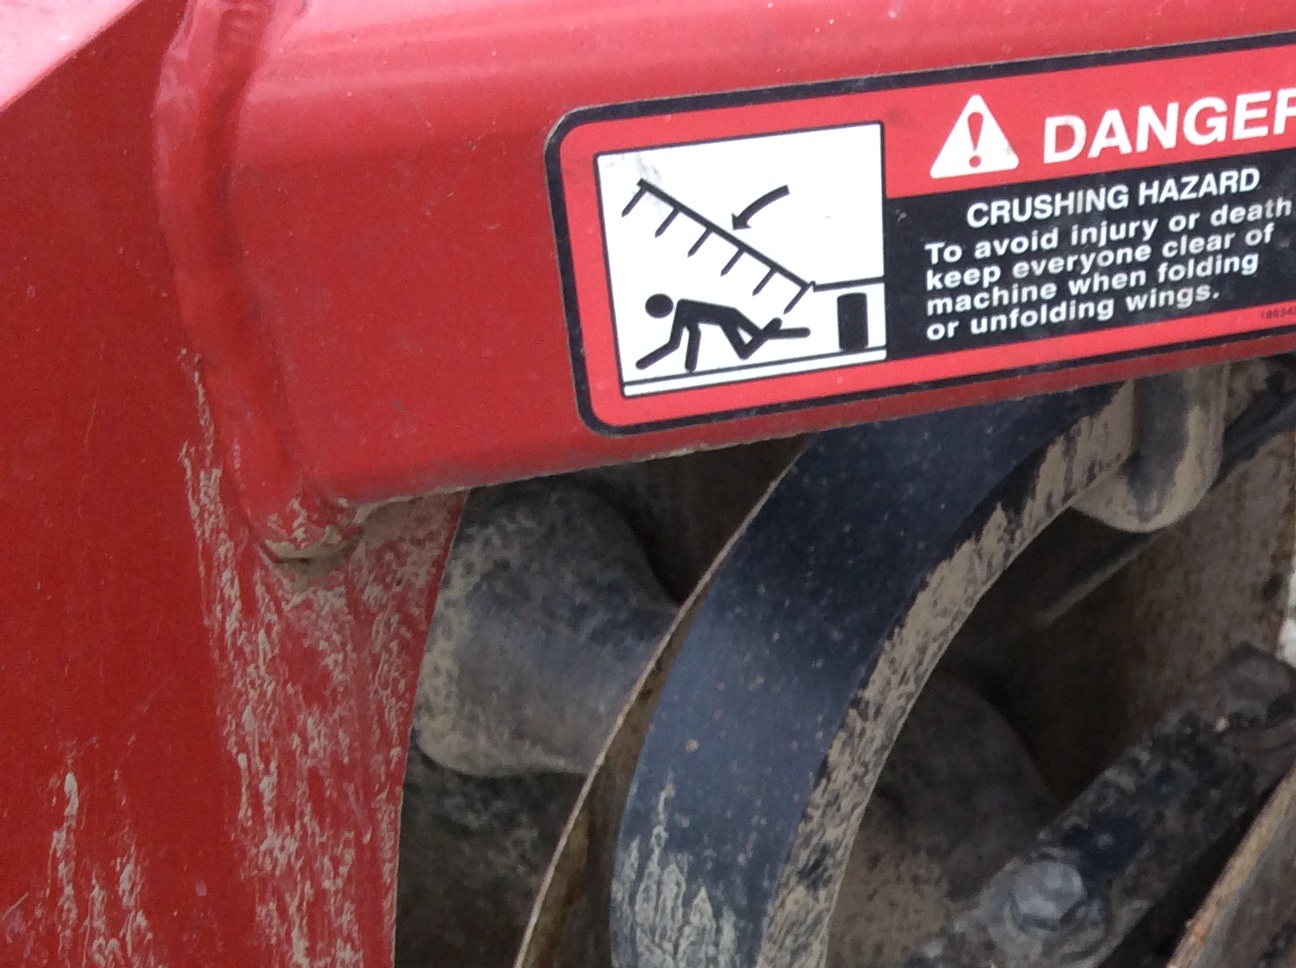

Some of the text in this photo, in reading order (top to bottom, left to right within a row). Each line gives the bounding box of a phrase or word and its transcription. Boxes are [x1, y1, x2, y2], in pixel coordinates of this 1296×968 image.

[967, 169, 1260, 228] CRUSHING HAZARD
[925, 199, 1291, 265] To avoid injury or death
[927, 223, 1274, 292] keep everyone clear of
[927, 253, 1259, 316] machine when folding
[927, 283, 1219, 341] or unfolding wings.
